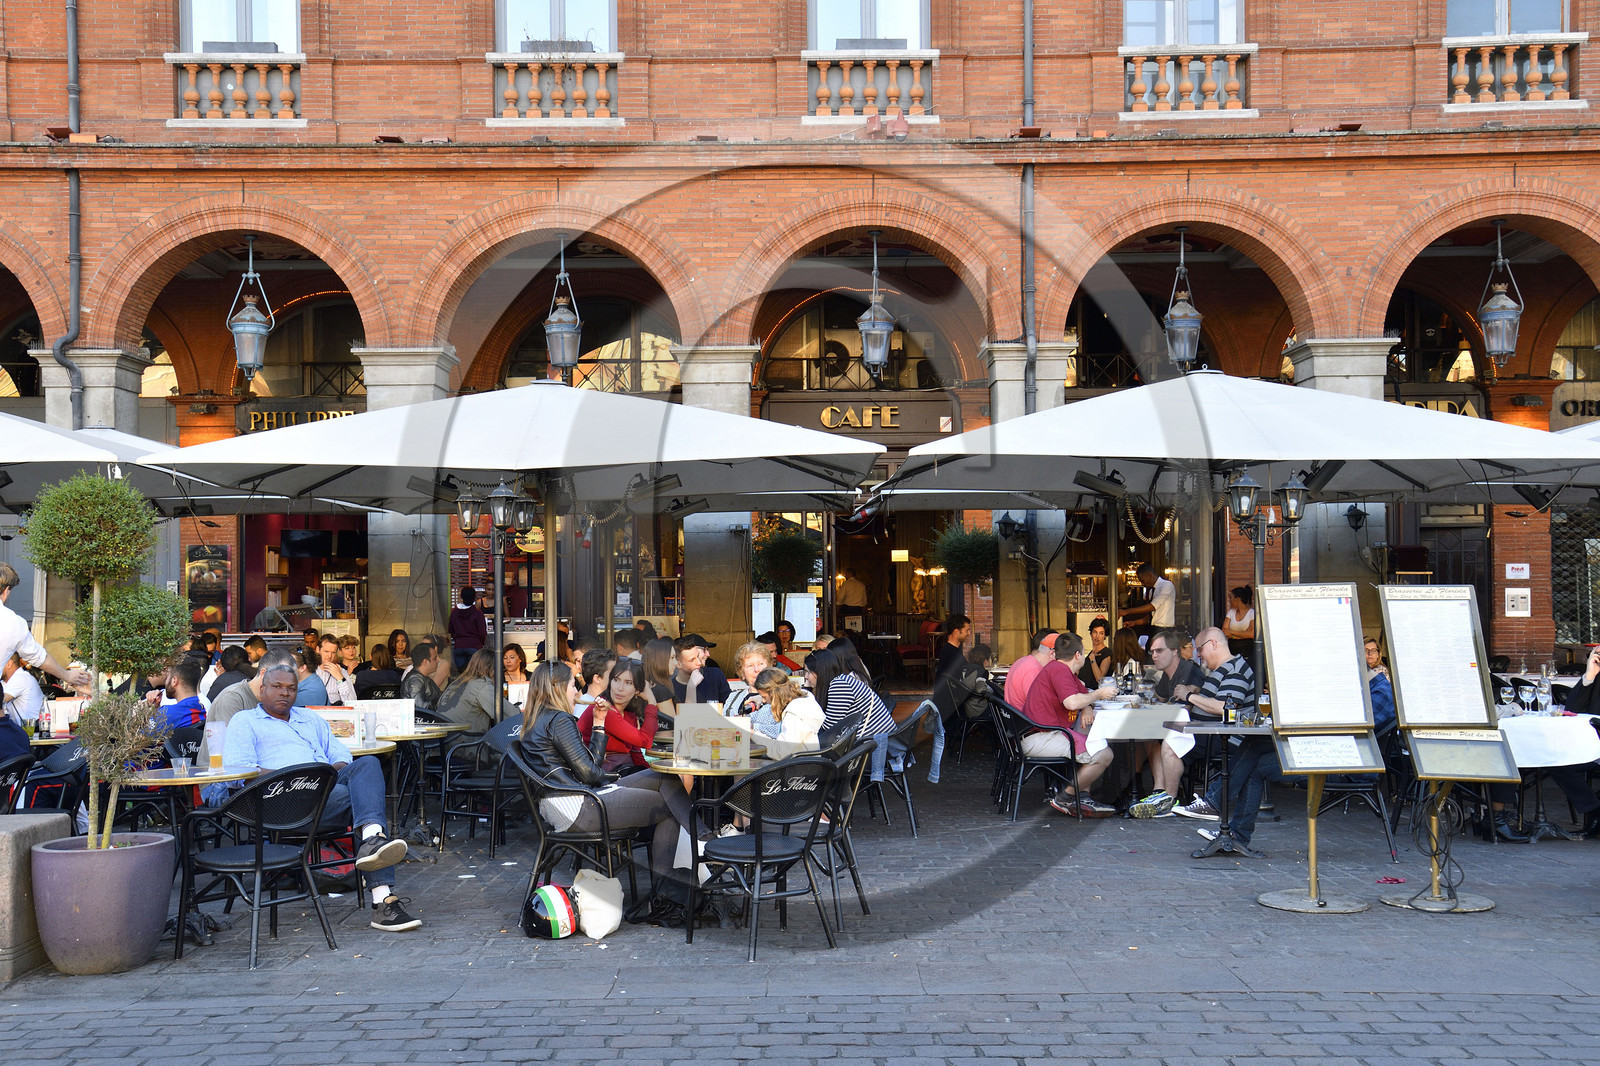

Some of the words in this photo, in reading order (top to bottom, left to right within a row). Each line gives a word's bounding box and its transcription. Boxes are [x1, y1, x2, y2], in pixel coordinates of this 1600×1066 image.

[820, 406, 900, 428] CAFE
[263, 780, 289, 799] Le
[287, 775, 321, 793] Florida
[761, 778, 782, 796] Le
[783, 775, 819, 793] Florida
